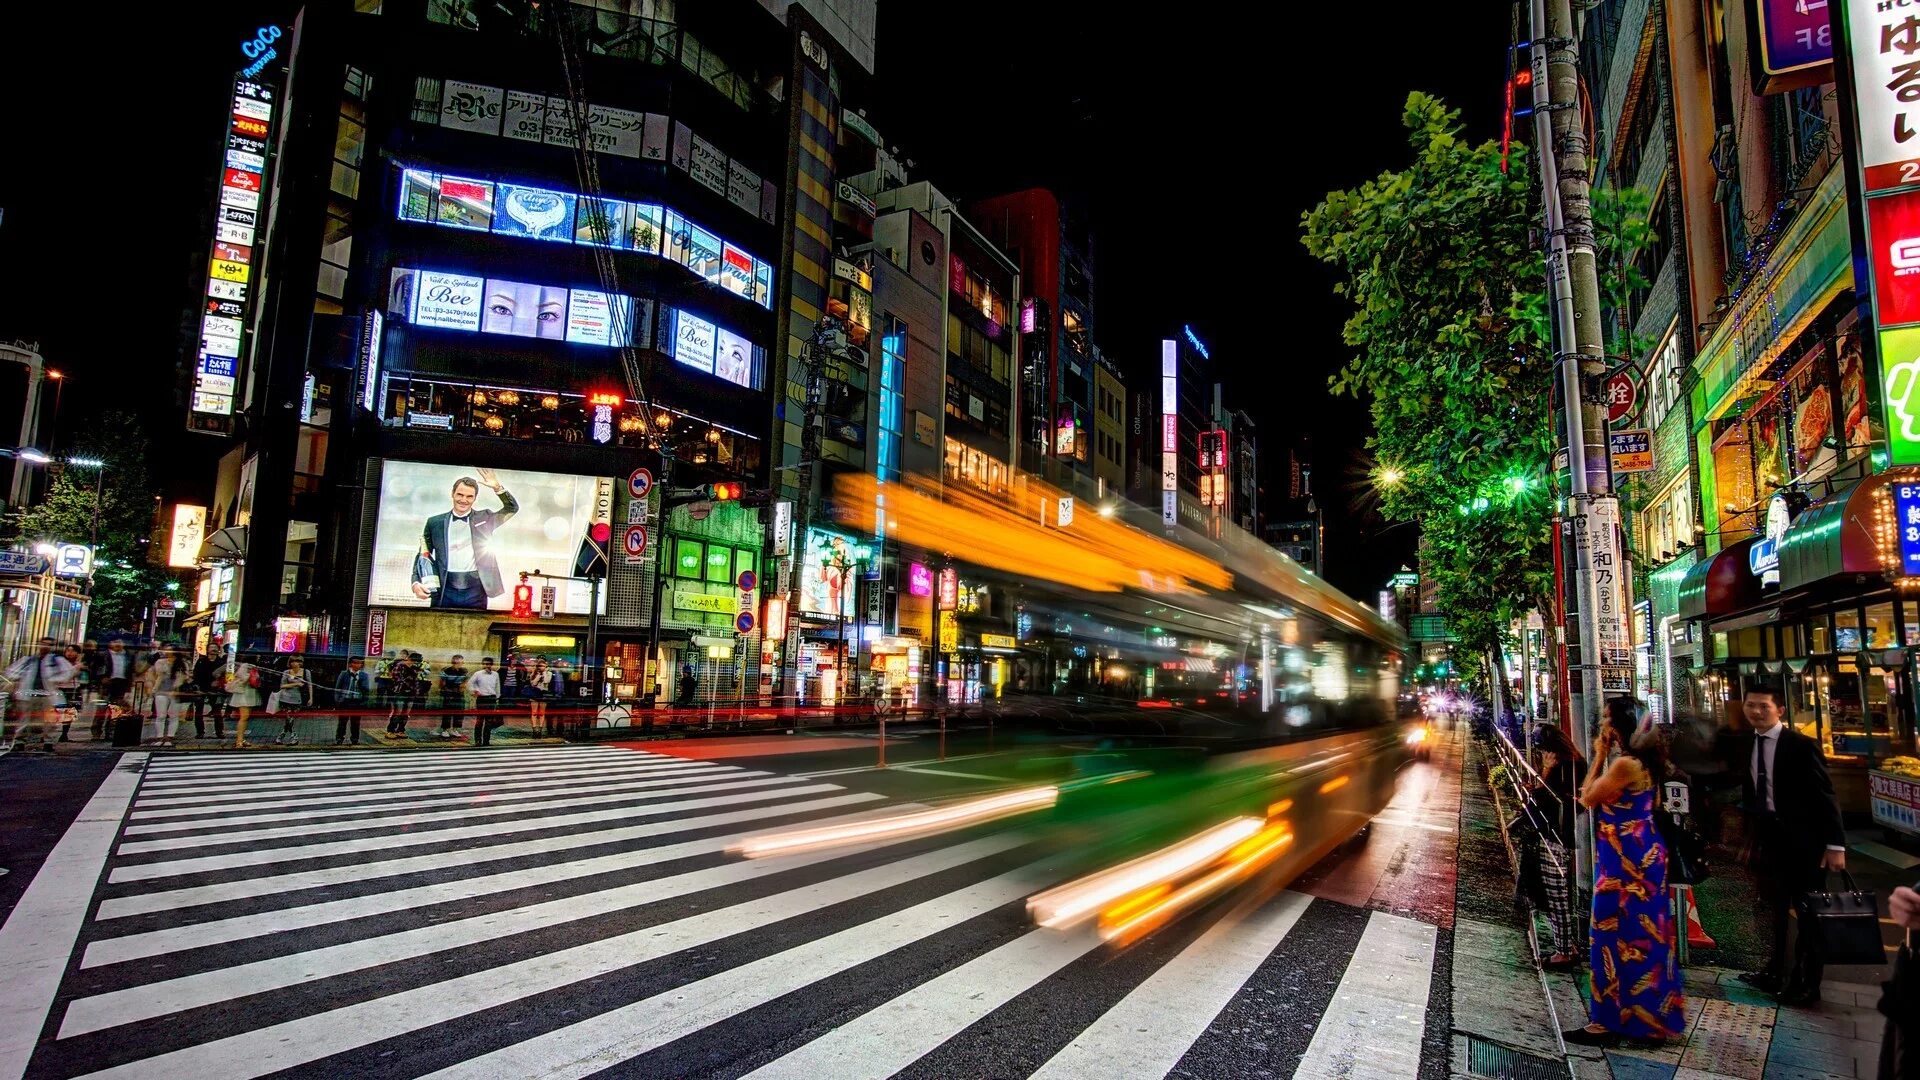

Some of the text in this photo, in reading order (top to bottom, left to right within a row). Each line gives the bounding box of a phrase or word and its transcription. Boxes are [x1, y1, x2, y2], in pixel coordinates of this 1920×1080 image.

[242, 25, 281, 58] CoCo
[426, 285, 475, 305] Bee
[364, 311, 373, 344] YAKINIKU
[680, 325, 709, 348] Bee
[209, 359, 232, 370] たんす屋
[359, 353, 367, 385] KANYOH
[1608, 381, 1630, 405] 栓
[598, 480, 610, 518] MOËT
[1593, 550, 1613, 584] 和乃
